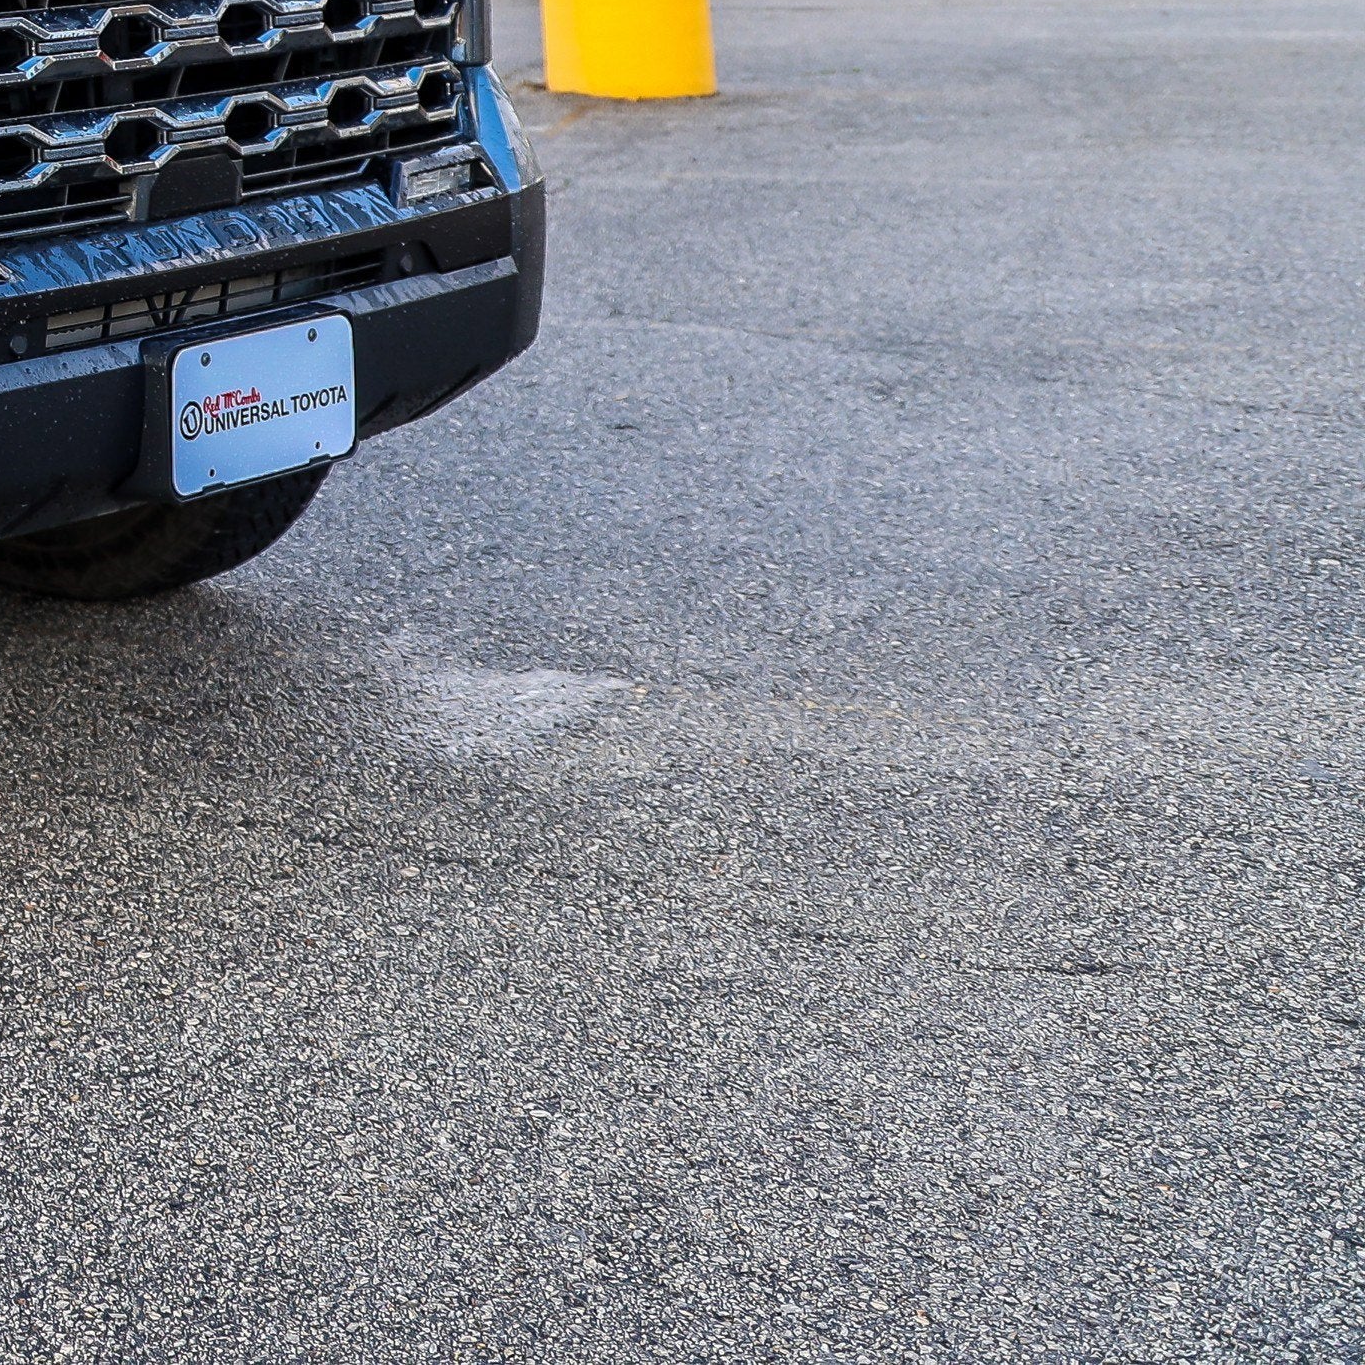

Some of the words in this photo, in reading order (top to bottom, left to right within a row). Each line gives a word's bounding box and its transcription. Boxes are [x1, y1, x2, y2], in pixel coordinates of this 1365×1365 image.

[203, 395, 221, 418] Red
[204, 401, 289, 434] UNIVERSAL
[290, 385, 347, 413] TOYOTA
